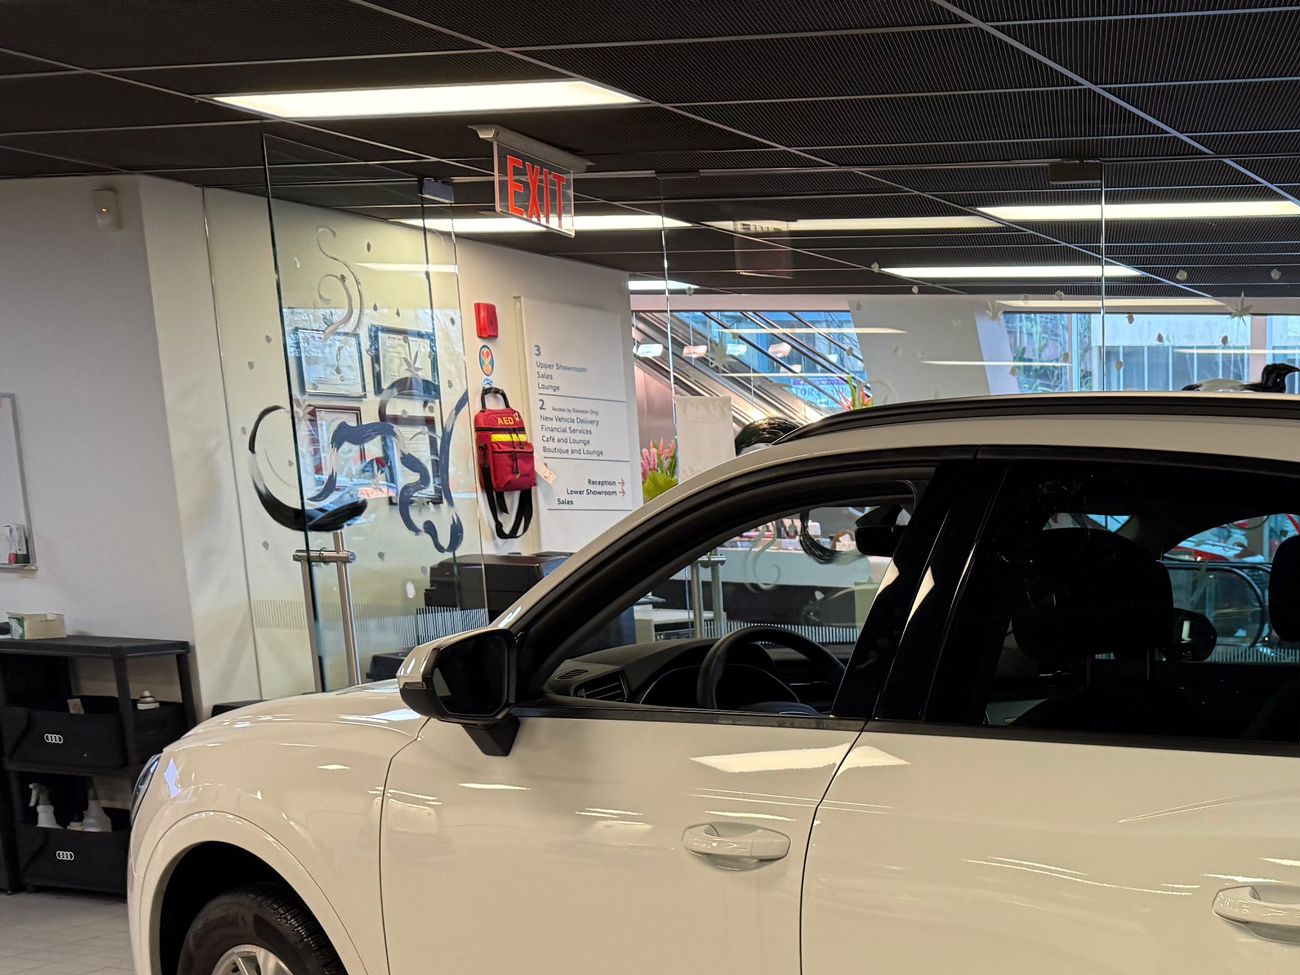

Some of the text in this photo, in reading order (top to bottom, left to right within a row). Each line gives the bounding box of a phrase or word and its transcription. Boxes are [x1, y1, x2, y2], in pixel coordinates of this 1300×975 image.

[507, 154, 567, 229] EXIT
[534, 344, 542, 357] 3
[536, 360, 555, 370] Upper
[536, 371, 553, 380] Sales
[537, 382, 560, 392] Lounge
[538, 398, 546, 410] 2
[497, 416, 514, 425] AED
[540, 413, 599, 427] New Vehicle Delivery
[541, 424, 592, 435] Financial Services
[541, 435, 590, 446] Café and Lounge
[542, 445, 604, 457] Boutique and Lounge
[587, 478, 617, 487] Reception
[566, 488, 618, 496] Lower Showroom
